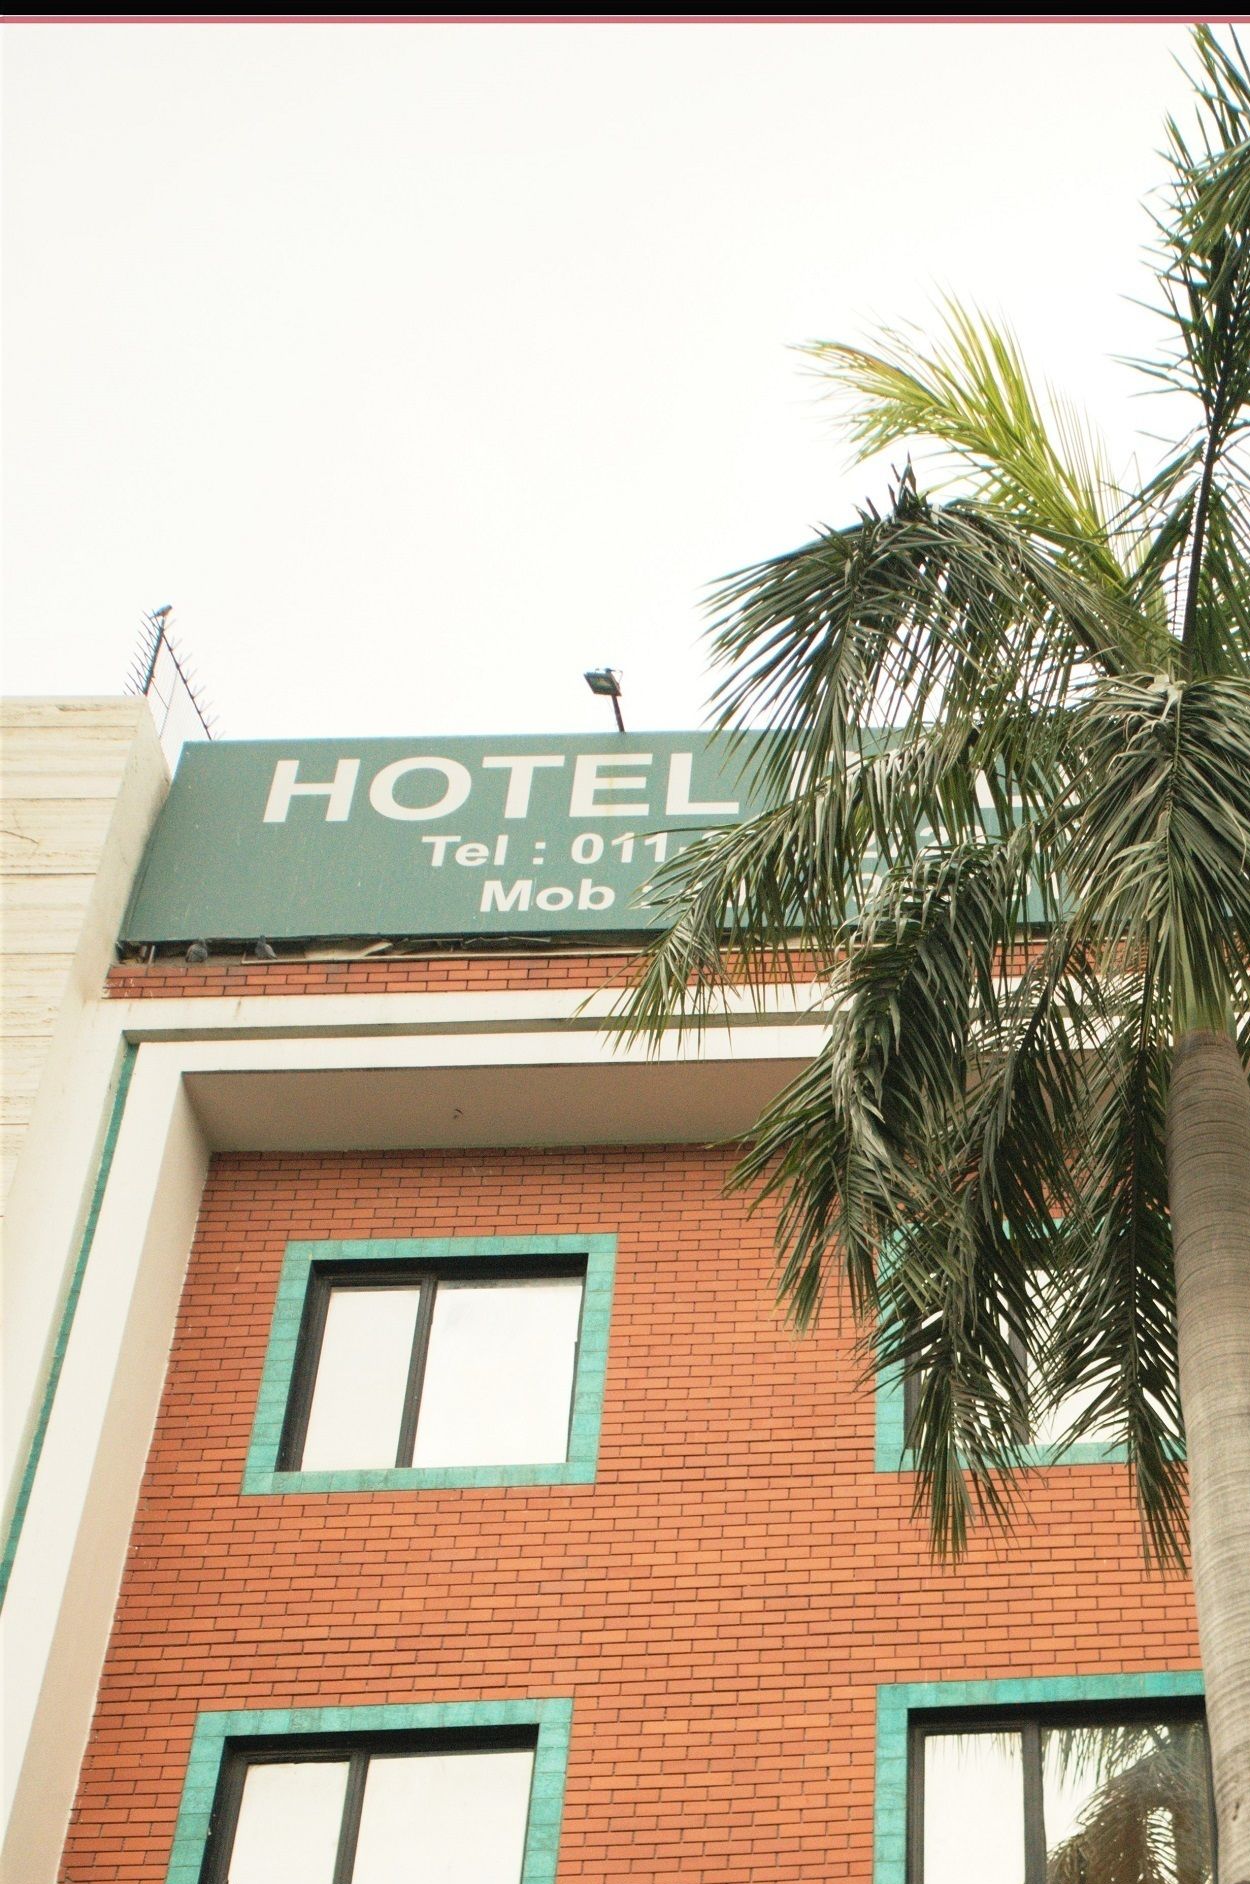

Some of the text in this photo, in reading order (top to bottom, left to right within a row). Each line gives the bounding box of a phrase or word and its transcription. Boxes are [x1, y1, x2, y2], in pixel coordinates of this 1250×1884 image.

[262, 751, 740, 823] HOTEL
[421, 833, 509, 868] Tel
[480, 878, 616, 912] Mob
